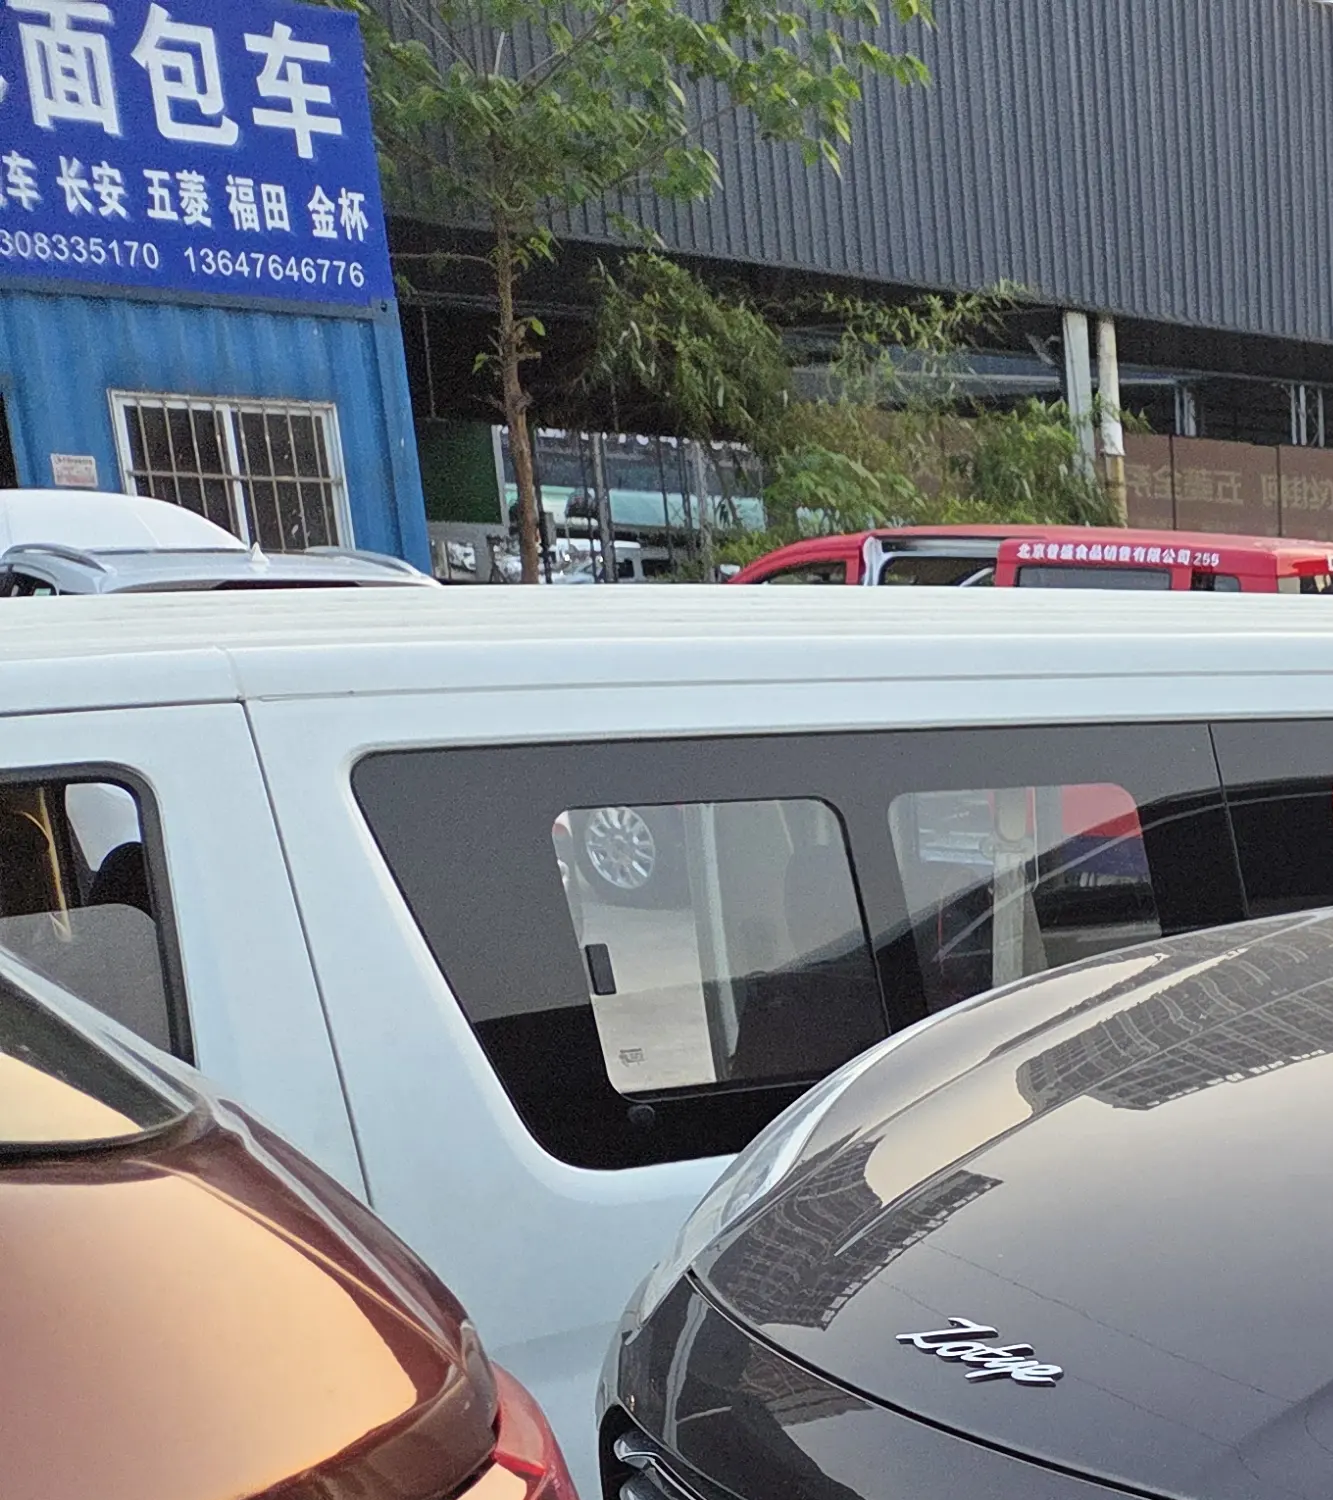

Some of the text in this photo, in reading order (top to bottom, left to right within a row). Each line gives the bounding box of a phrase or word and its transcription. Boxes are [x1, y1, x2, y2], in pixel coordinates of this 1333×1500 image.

[0, 0, 343, 159] 面包车
[0, 150, 369, 242] 车 长安 五菱 福田 金杯
[0, 229, 365, 288] 308335170 13647646776
